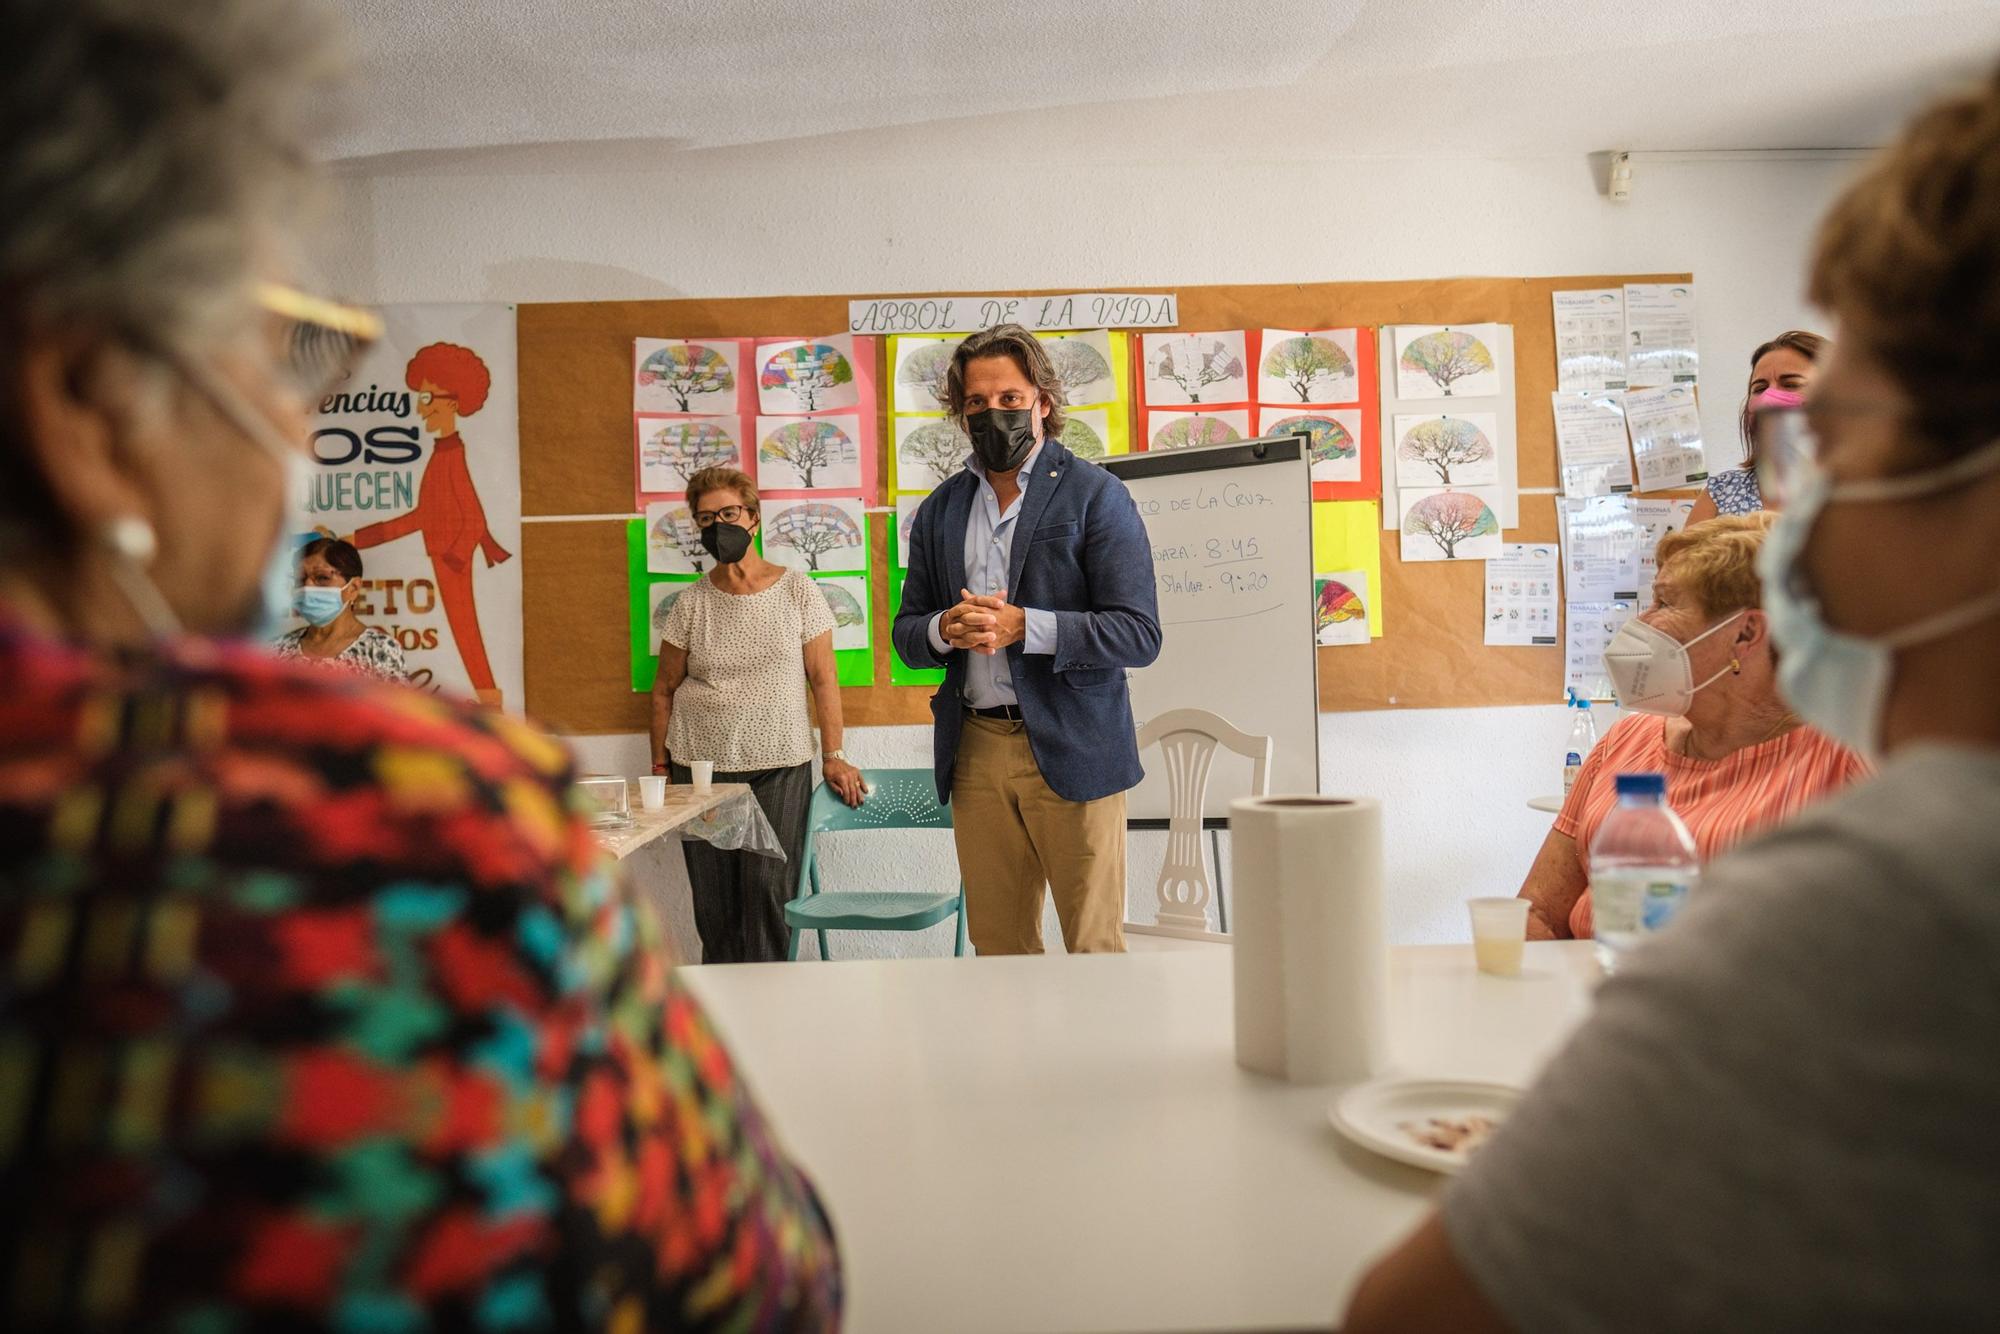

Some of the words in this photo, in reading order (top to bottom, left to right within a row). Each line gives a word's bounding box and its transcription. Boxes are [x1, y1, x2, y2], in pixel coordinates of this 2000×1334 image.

[978, 300, 1019, 329] DE
[1035, 298, 1073, 327] LA
[1091, 297, 1174, 325] VIDA
[319, 384, 411, 417] encias
[1170, 498, 1191, 511] DE
[1220, 571, 1268, 594] 9:20
